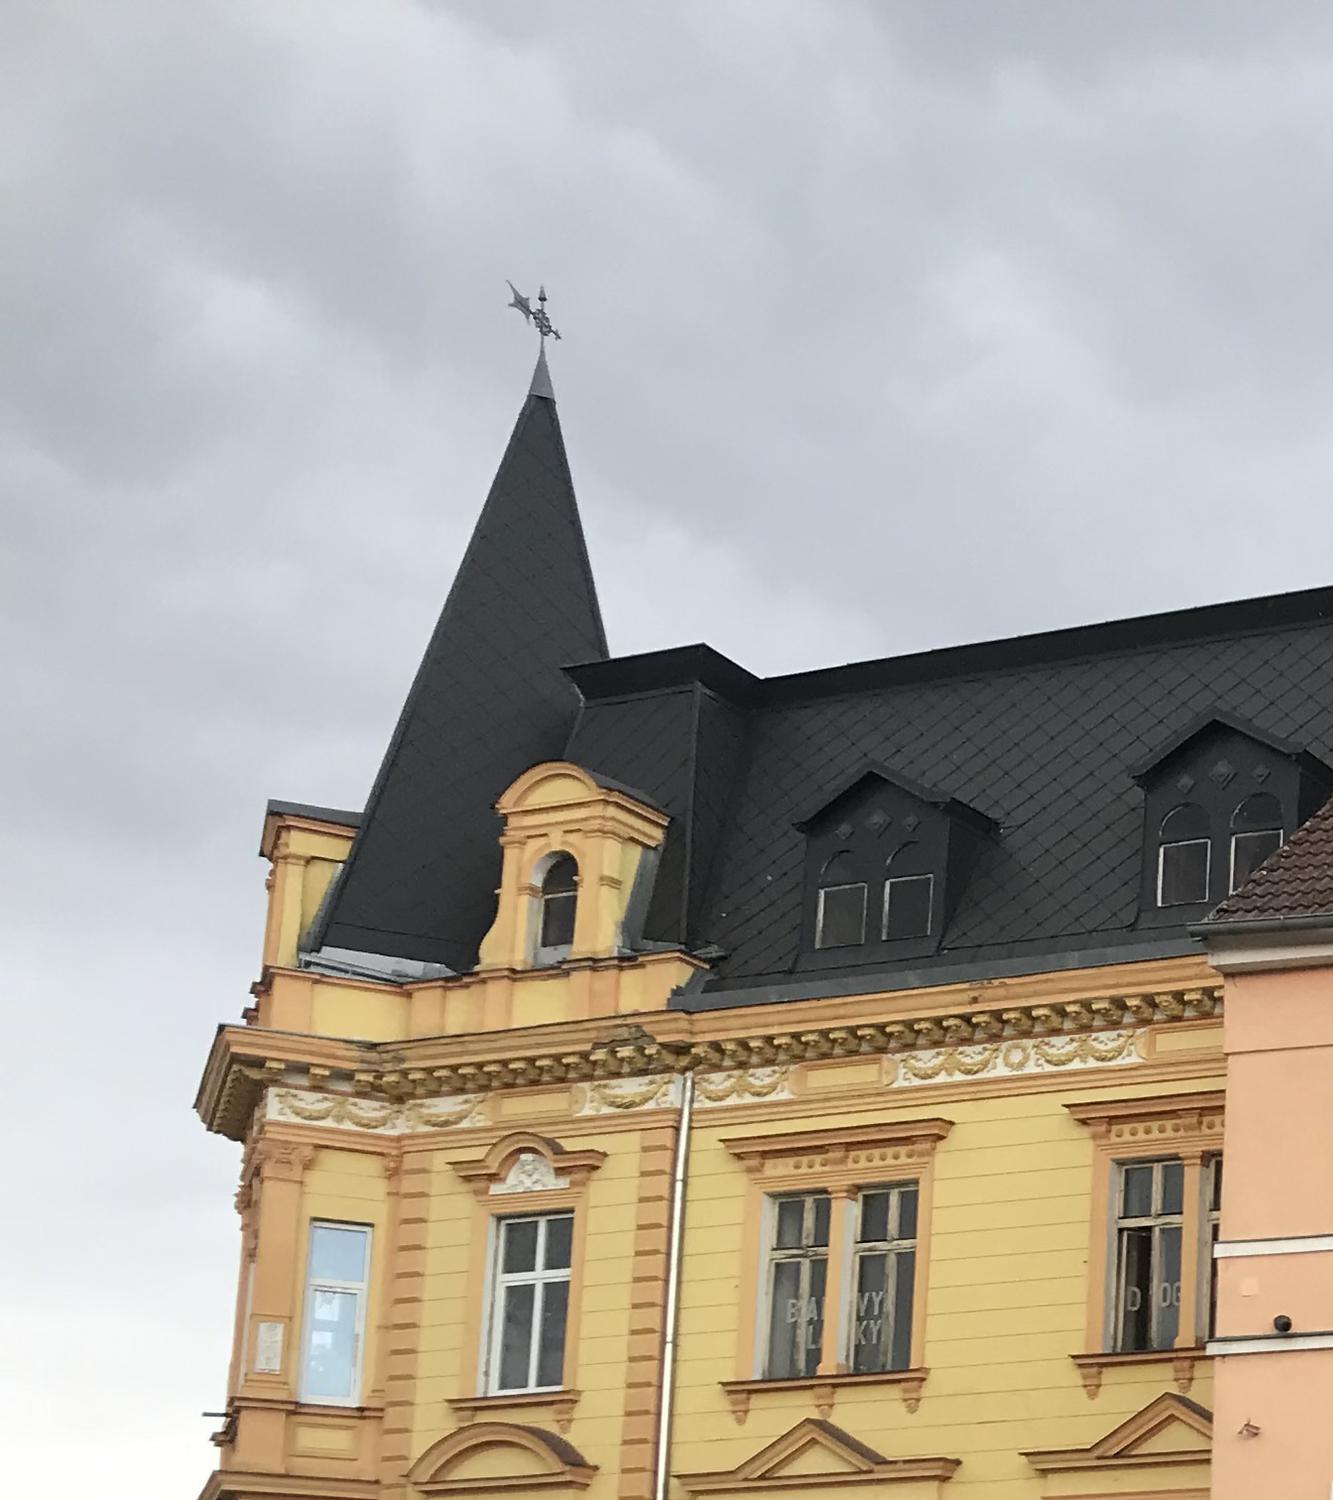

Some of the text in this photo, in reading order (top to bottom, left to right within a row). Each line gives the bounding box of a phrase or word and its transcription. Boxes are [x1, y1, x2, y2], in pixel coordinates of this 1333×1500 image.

[786, 1291, 884, 1323] BAVY
[1127, 1282, 1181, 1311] DOG
[806, 1320, 882, 1349] LKY
